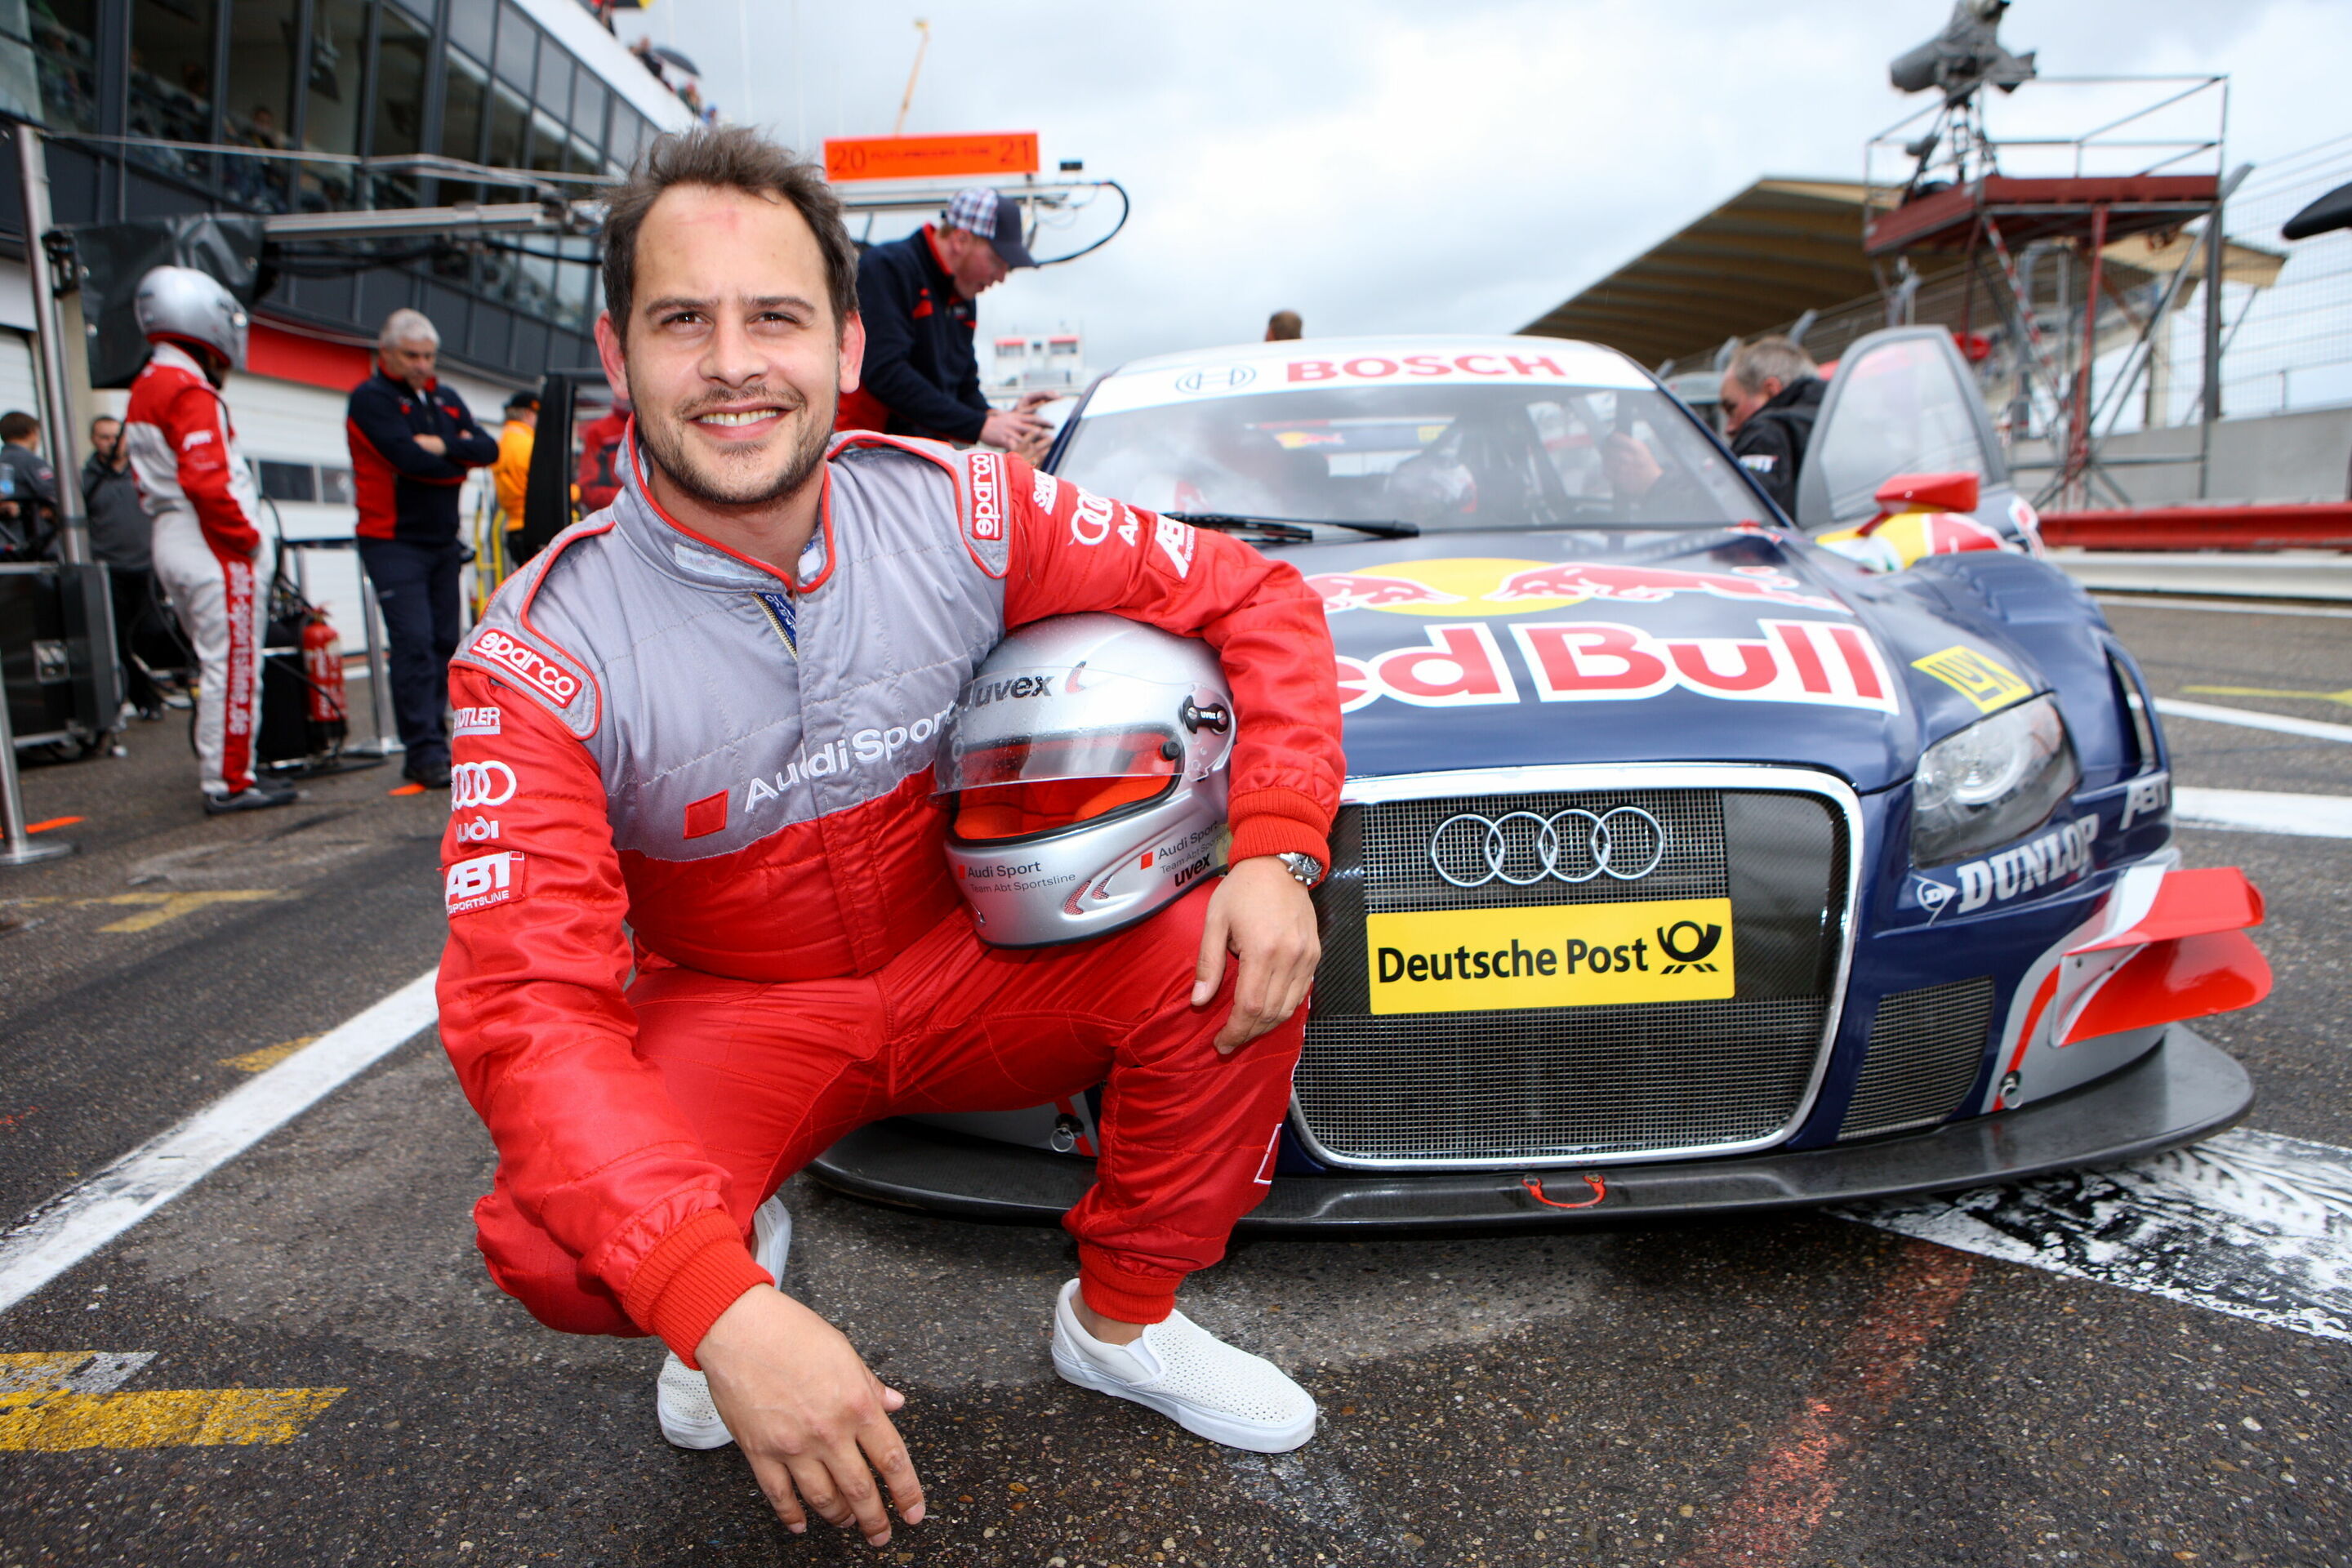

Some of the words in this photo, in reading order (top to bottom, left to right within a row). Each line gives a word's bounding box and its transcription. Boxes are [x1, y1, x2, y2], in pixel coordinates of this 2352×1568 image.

[831, 144, 866, 174] 20
[997, 138, 1030, 166] 21
[1287, 354, 1567, 383] BOSCH
[480, 630, 576, 696] sparco
[1512, 621, 1895, 712] Bull
[975, 676, 1054, 708] uvex
[1158, 837, 1188, 860] Audi
[1189, 820, 1218, 844] Sport
[968, 866, 994, 878] Audi
[996, 862, 1041, 879] Sport
[1160, 858, 1185, 874] Team
[1186, 849, 1200, 862] Abt
[1174, 852, 1210, 887] uvex
[1957, 813, 2100, 914] DUNLOP
[445, 852, 510, 916] ABT
[969, 883, 992, 893] Team
[994, 884, 1012, 893] Abt
[1013, 873, 1076, 892] Sportsline
[1378, 938, 1557, 982] Deutsche
[1566, 937, 1649, 975] Post
